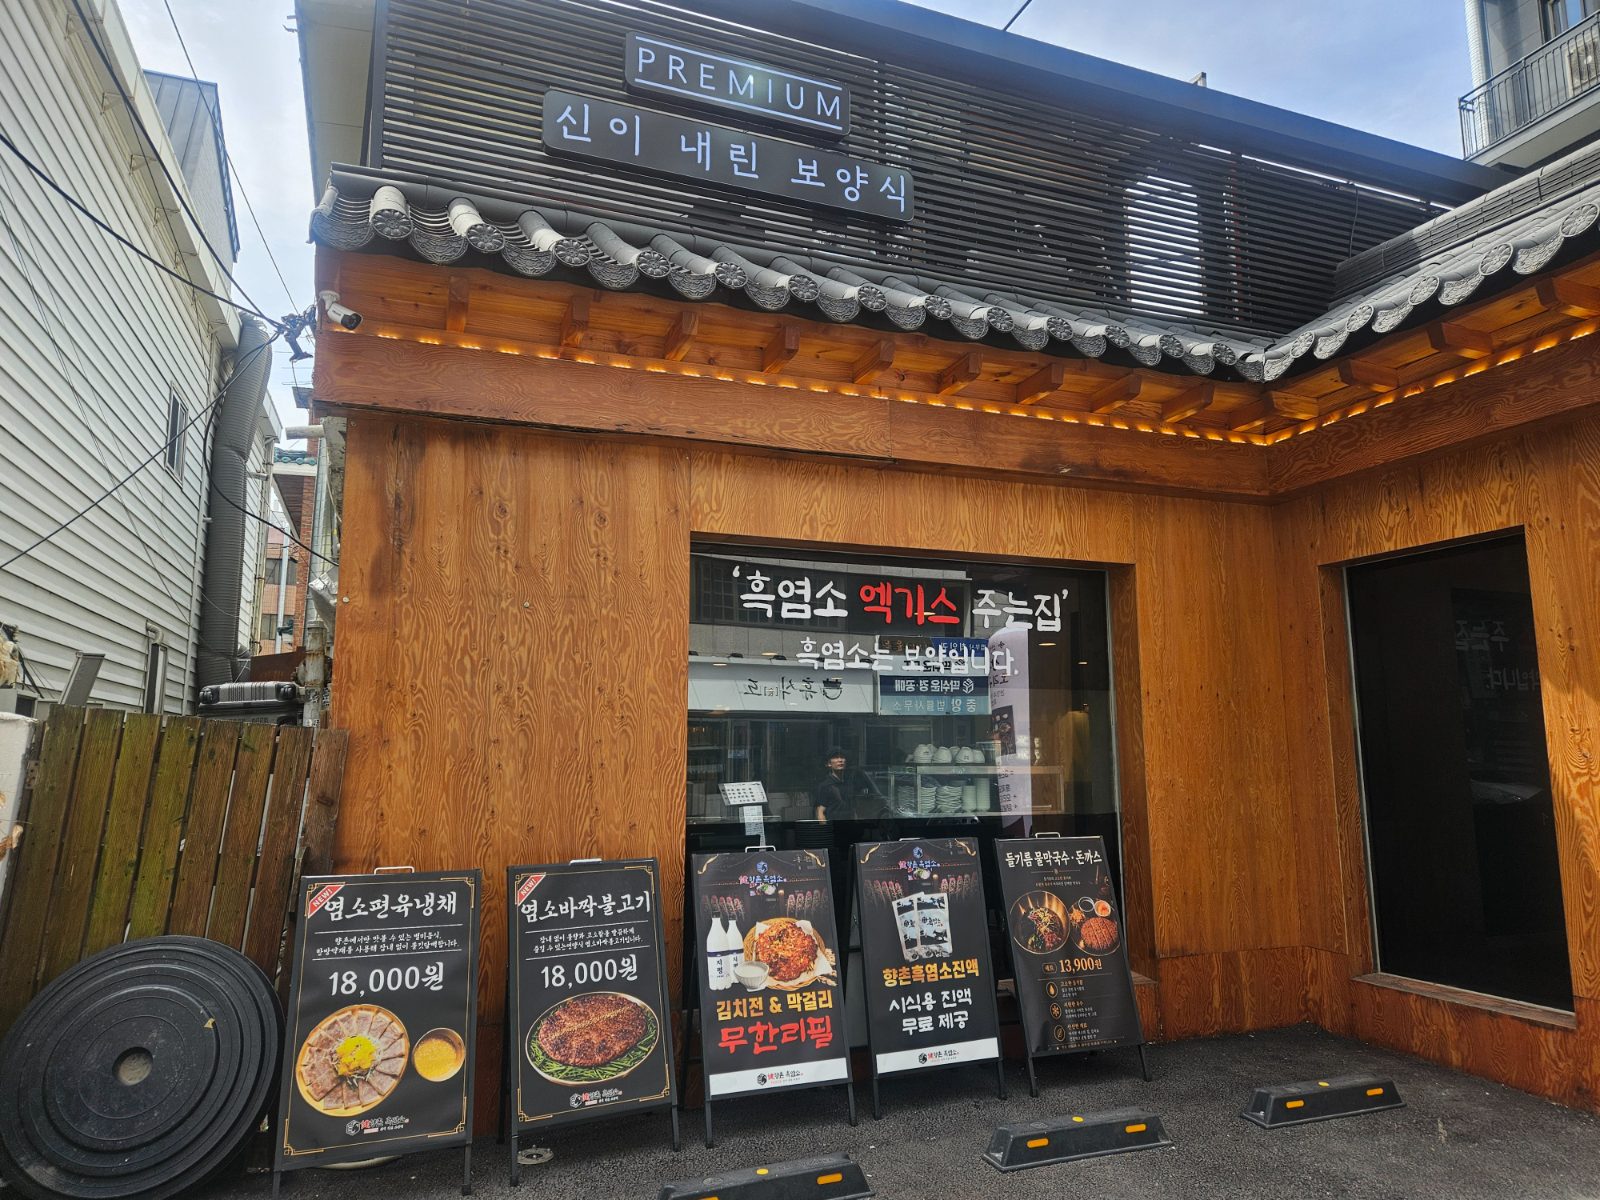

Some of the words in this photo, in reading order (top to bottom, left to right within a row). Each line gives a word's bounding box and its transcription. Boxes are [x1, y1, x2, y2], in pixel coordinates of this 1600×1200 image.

[637, 47, 841, 121] PREMIUM
[556, 103, 641, 156] 신이
[680, 131, 759, 180] 내린
[790, 157, 907, 213] 보양식
[858, 581, 961, 626] 엑기스
[795, 636, 895, 672] 흑염소는
[1005, 851, 1034, 868] 들기름
[312, 888, 333, 908] NEW!
[521, 879, 537, 896] NEW!
[324, 891, 457, 922] 염소편육냉채
[520, 890, 651, 924] 염소바짝불고기
[328, 961, 444, 998] 18,000원
[540, 953, 638, 989] 18,000원
[882, 957, 980, 988] 향촌흑염소진액
[1059, 956, 1103, 974] 13,900원
[716, 996, 764, 1021] 김치전
[769, 997, 782, 1014] &
[786, 989, 833, 1012] 막걸리
[889, 991, 937, 1015] 시식용
[940, 987, 973, 1010] 진액
[718, 1015, 833, 1056] 무한리필
[902, 1015, 934, 1036] 무료
[938, 1010, 969, 1030] 제공
